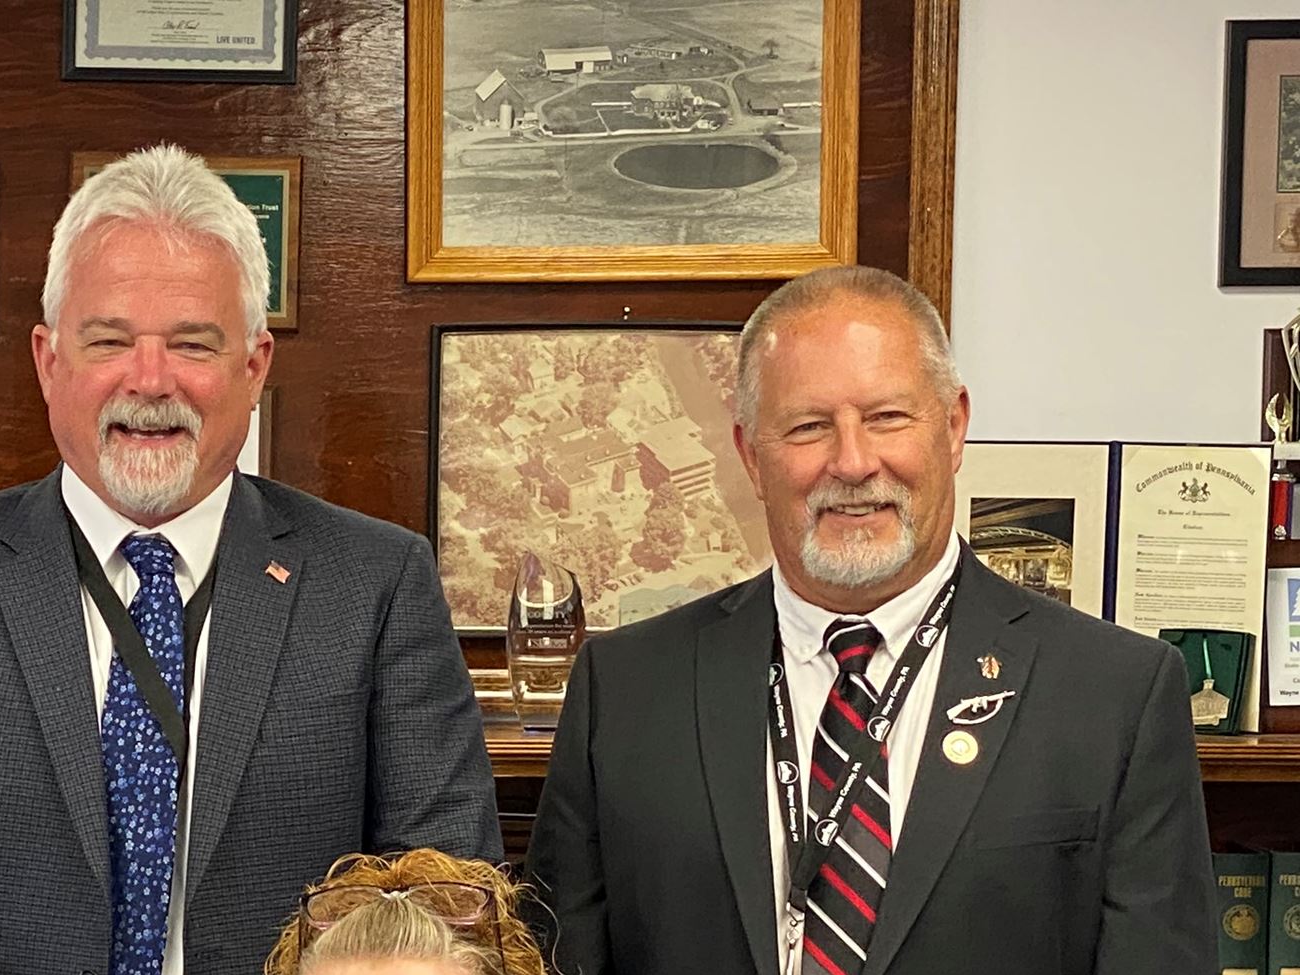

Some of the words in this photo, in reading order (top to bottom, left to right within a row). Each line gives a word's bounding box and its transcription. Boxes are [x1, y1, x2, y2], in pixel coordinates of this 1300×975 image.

[216, 35, 230, 44] LIVE
[232, 36, 256, 45] UNITED
[262, 203, 279, 211] Trust
[1136, 461, 1193, 493] Commonwealth
[1195, 462, 1203, 471] of
[1205, 462, 1256, 496] Pennsylvania
[900, 666, 910, 676] PA
[780, 728, 788, 738] PA
[829, 796, 845, 818] Wayne
[839, 769, 860, 797] County,
[852, 762, 863, 772] PA
[1234, 887, 1252, 898] CODE
